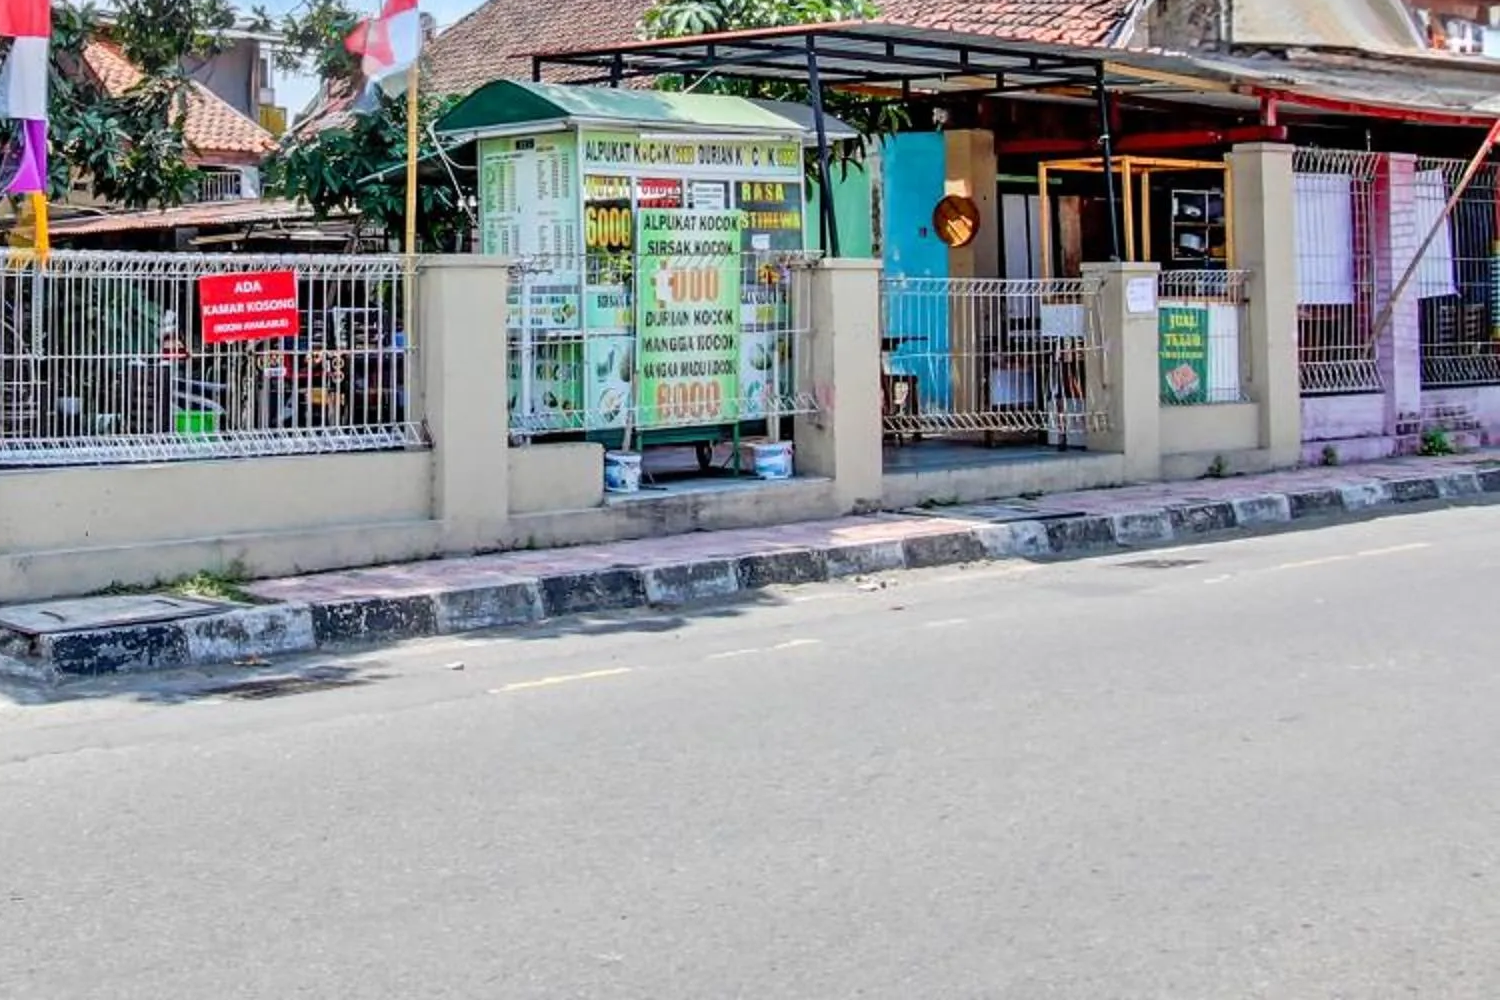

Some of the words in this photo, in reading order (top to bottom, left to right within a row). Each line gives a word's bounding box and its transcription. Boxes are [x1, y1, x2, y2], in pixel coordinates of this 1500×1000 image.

[585, 140, 631, 162] ALPUKAT
[698, 144, 734, 165] DURIAN
[740, 182, 785, 201] RASA
[586, 207, 631, 247] 6000
[643, 214, 698, 232] ALPUKAT
[699, 214, 740, 232] KOCOK
[740, 210, 801, 230] STIMEWA
[647, 239, 691, 256] SIRSAK
[694, 239, 733, 257] KOCOK
[234, 281, 262, 294] ADA
[203, 304, 245, 316] KAMAR
[247, 298, 295, 312] KOSONG
[645, 311, 690, 328] DURIAN
[692, 309, 734, 326] KOCOK
[643, 336, 694, 353] MANGGA
[697, 334, 736, 352] KOCOK
